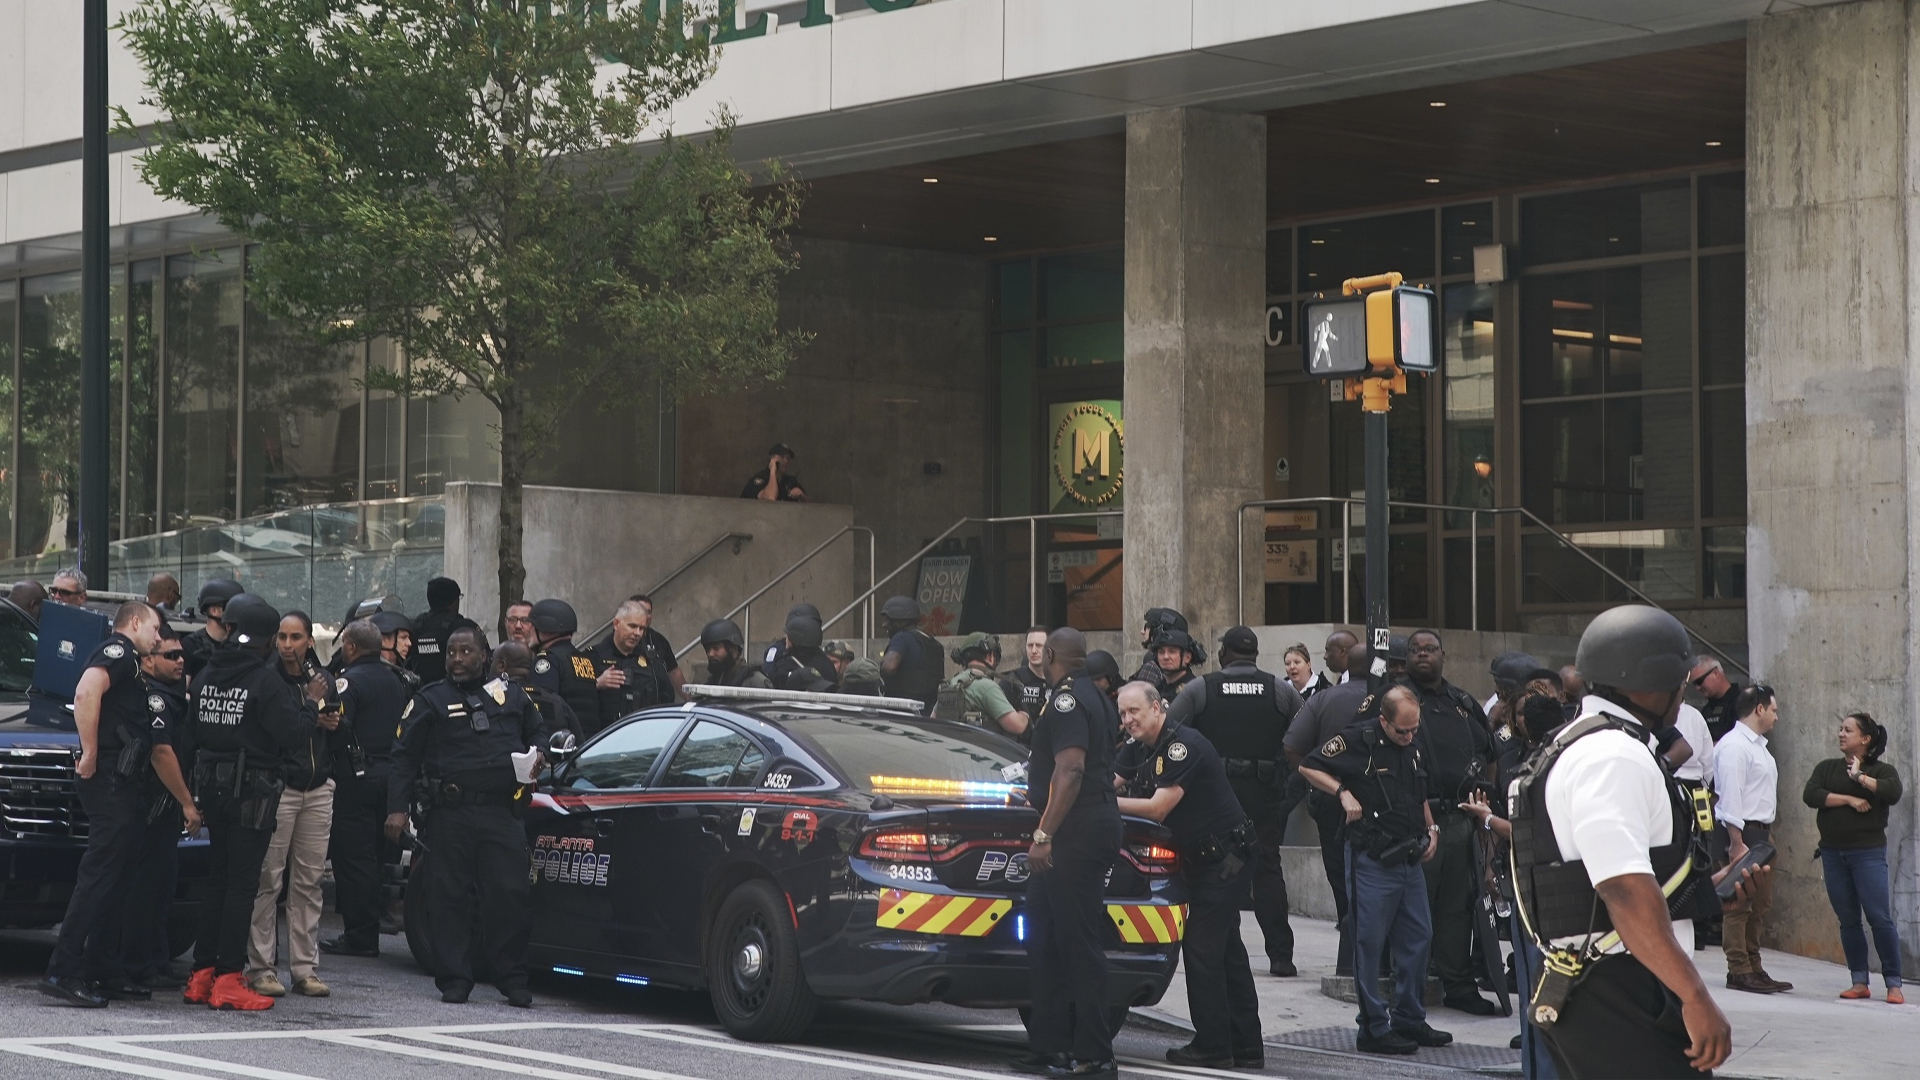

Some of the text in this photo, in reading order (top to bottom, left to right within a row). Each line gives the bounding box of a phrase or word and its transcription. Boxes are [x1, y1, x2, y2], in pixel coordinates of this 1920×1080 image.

[1076, 403, 1104, 415] FOODS
[1074, 429, 1110, 477] M
[924, 571, 966, 587] NOW
[920, 588, 963, 603] OPEN
[574, 664, 596, 680] POLICE
[200, 684, 248, 700] ATLANTA
[1023, 687, 1039, 697] ATF
[1222, 682, 1264, 695] SHERIFF
[199, 698, 245, 713] POLICE
[198, 710, 244, 725] GANG UNIT
[764, 772, 792, 789] 34353
[792, 812, 811, 820] DIAL
[781, 828, 814, 842] 9-1-1
[535, 835, 594, 852] ATLANTA
[531, 848, 611, 887] POLICE
[889, 864, 932, 882] 34353
